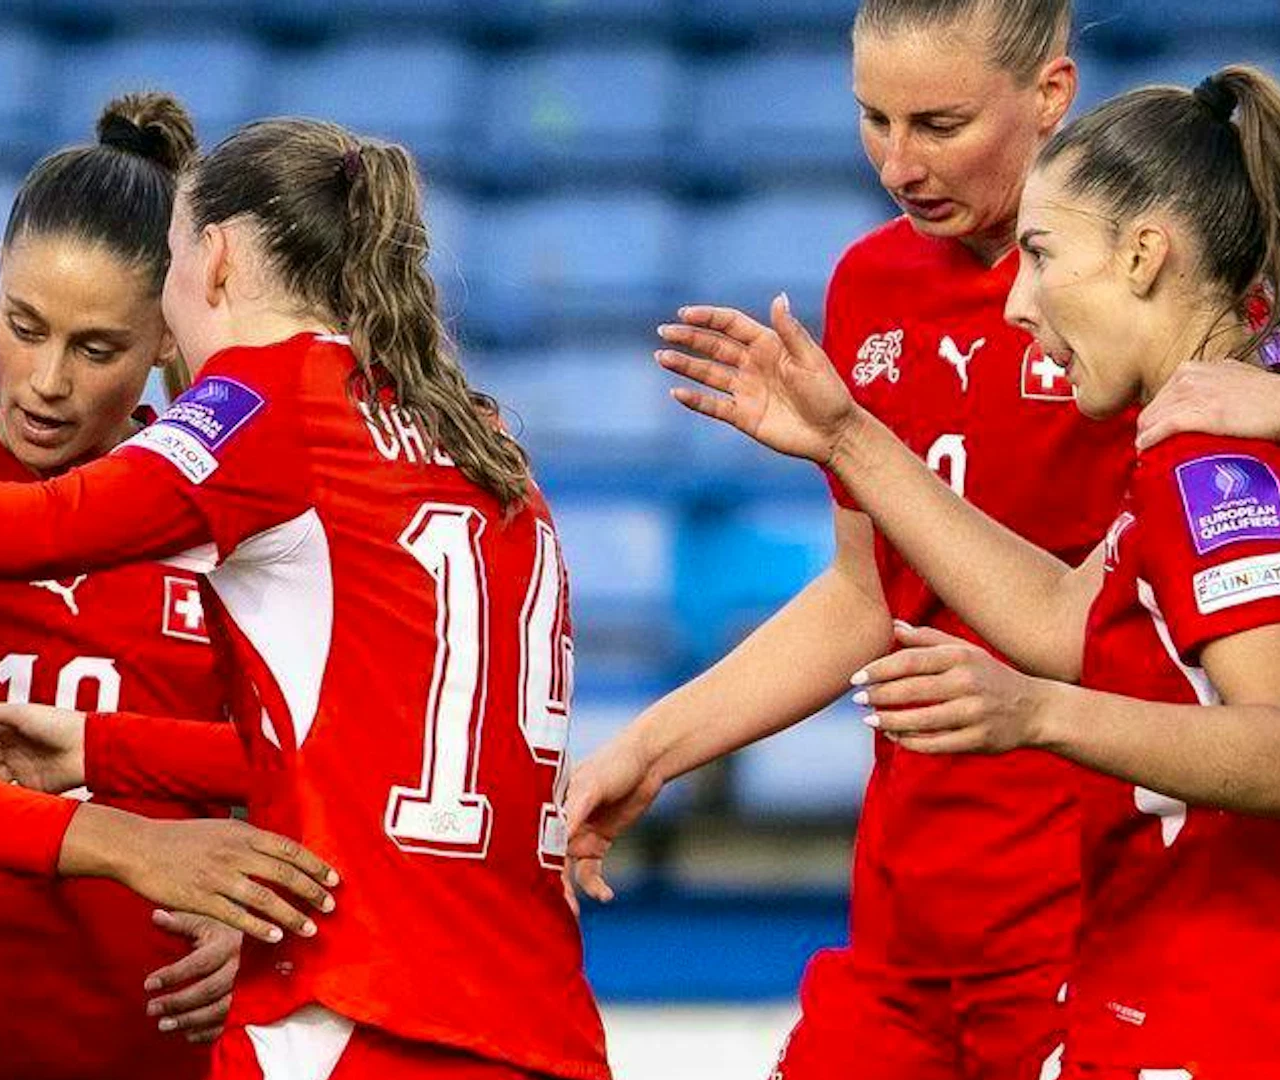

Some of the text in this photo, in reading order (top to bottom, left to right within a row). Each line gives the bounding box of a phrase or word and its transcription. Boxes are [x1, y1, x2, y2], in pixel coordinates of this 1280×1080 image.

[1198, 504, 1277, 528] EUROPEAN
[1200, 515, 1280, 540] QUALIFIERS
[384, 502, 573, 871] 14
